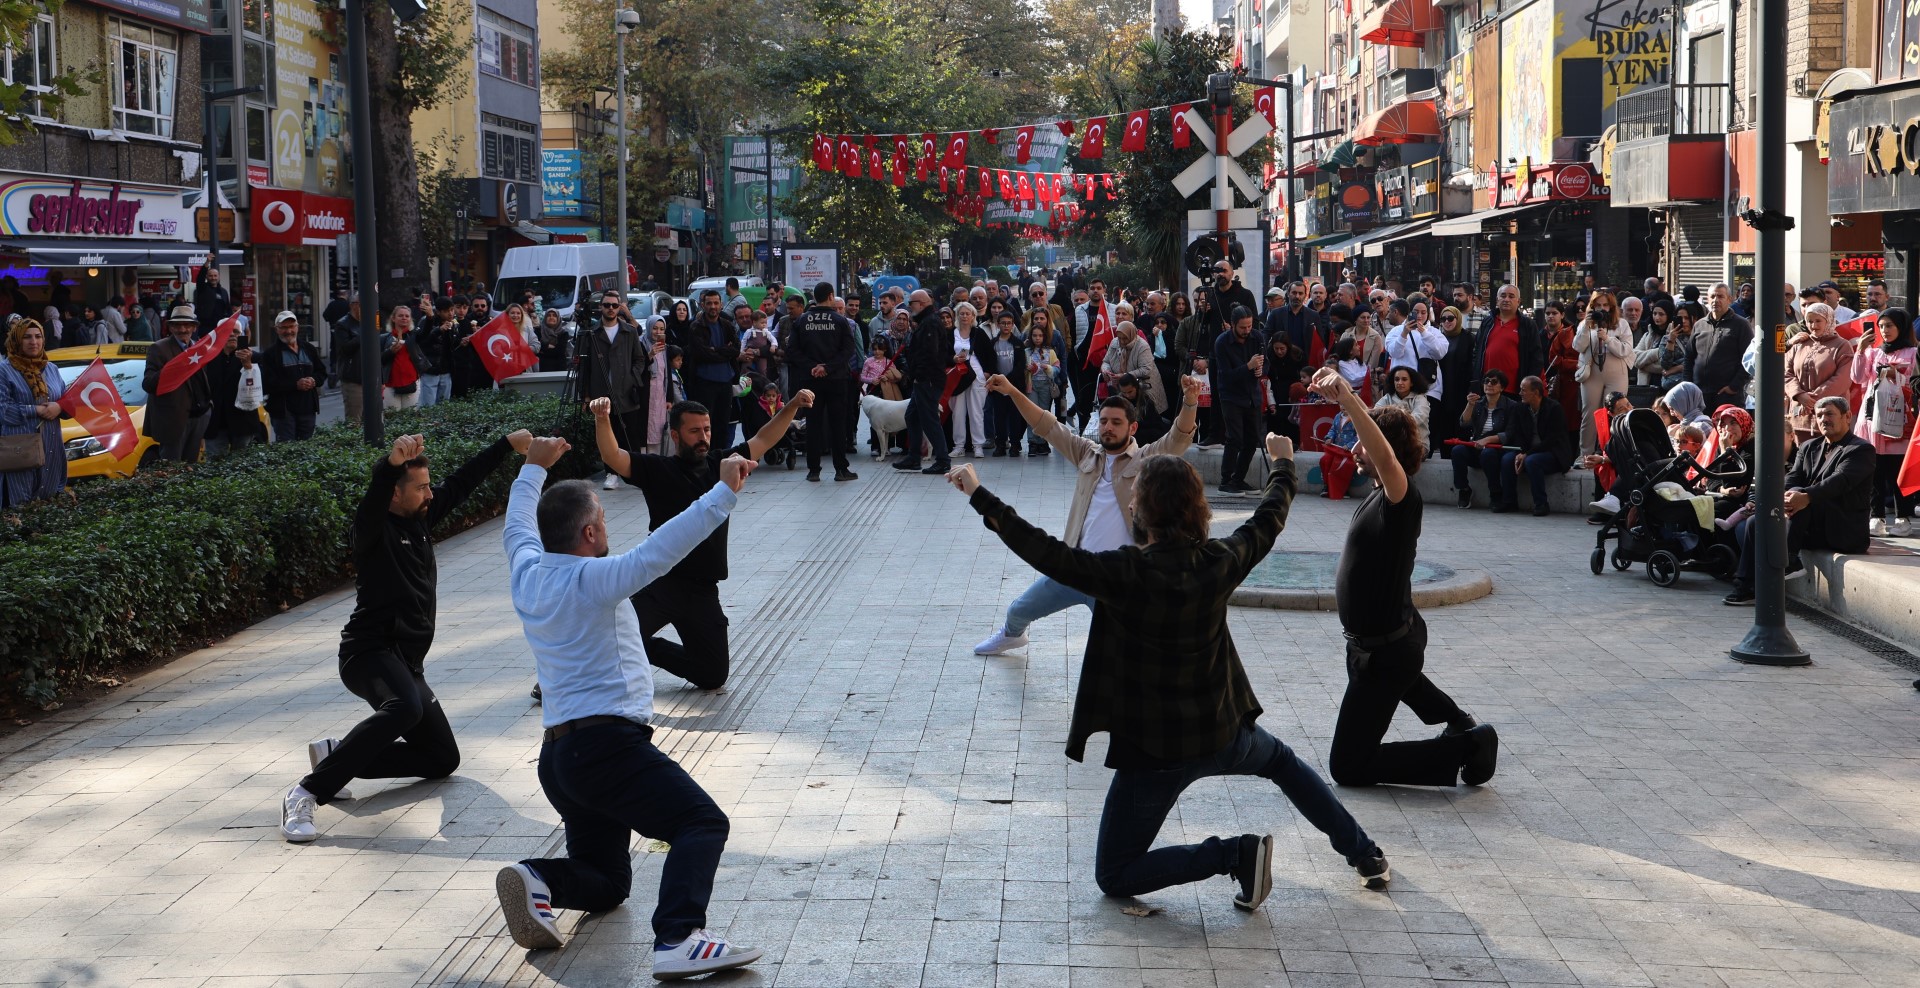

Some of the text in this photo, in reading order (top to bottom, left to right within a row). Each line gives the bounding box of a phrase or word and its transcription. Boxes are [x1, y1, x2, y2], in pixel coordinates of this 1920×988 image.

[1596, 29, 1670, 55] BURA
[279, 129, 303, 167] 24
[27, 179, 140, 235] serbesler
[308, 210, 345, 231] vodafone
[1736, 254, 1754, 266] Rose
[807, 313, 833, 322] ÖZEL
[805, 322, 836, 331] GÜVENLİK
[123, 345, 147, 353] TAKS
